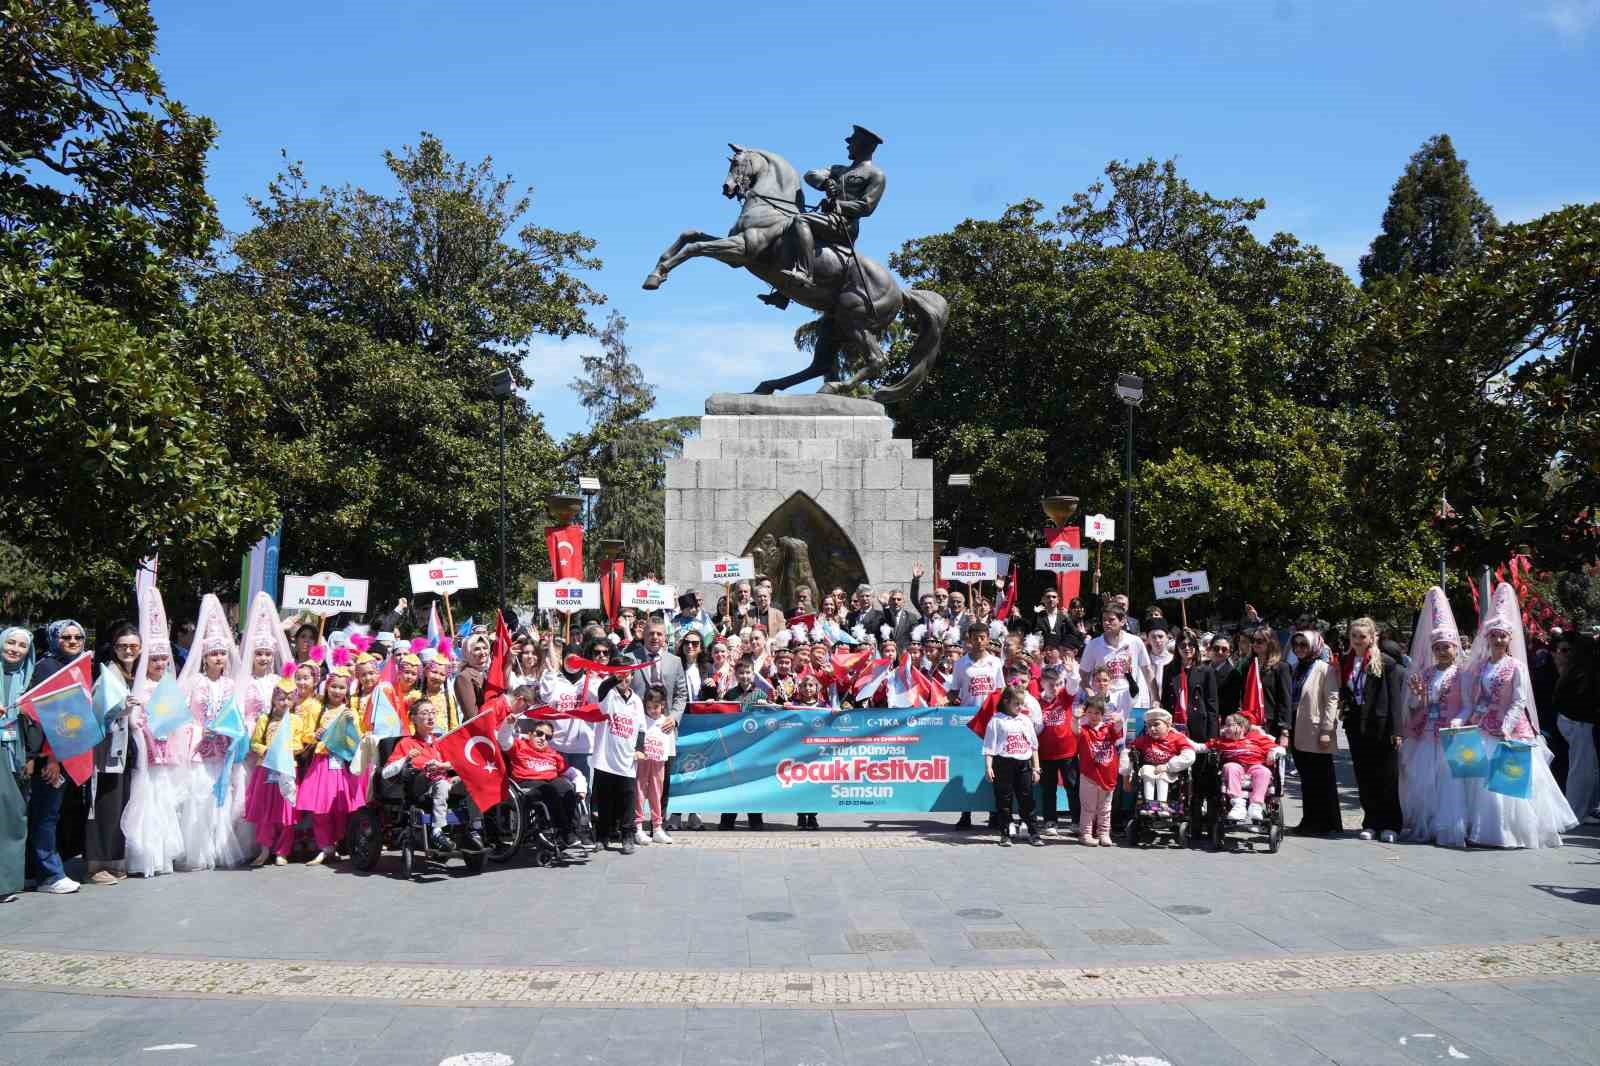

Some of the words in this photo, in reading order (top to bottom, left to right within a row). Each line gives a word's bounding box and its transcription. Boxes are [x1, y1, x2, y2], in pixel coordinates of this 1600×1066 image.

[298, 597, 352, 607] KAZAKISTAN
[819, 747, 829, 756] 2.
[831, 745, 857, 756] Türk
[858, 744, 905, 758] Dünyası
[776, 758, 850, 785] Çocuk
[853, 757, 948, 782] Festivali
[831, 785, 894, 798] Samsun
